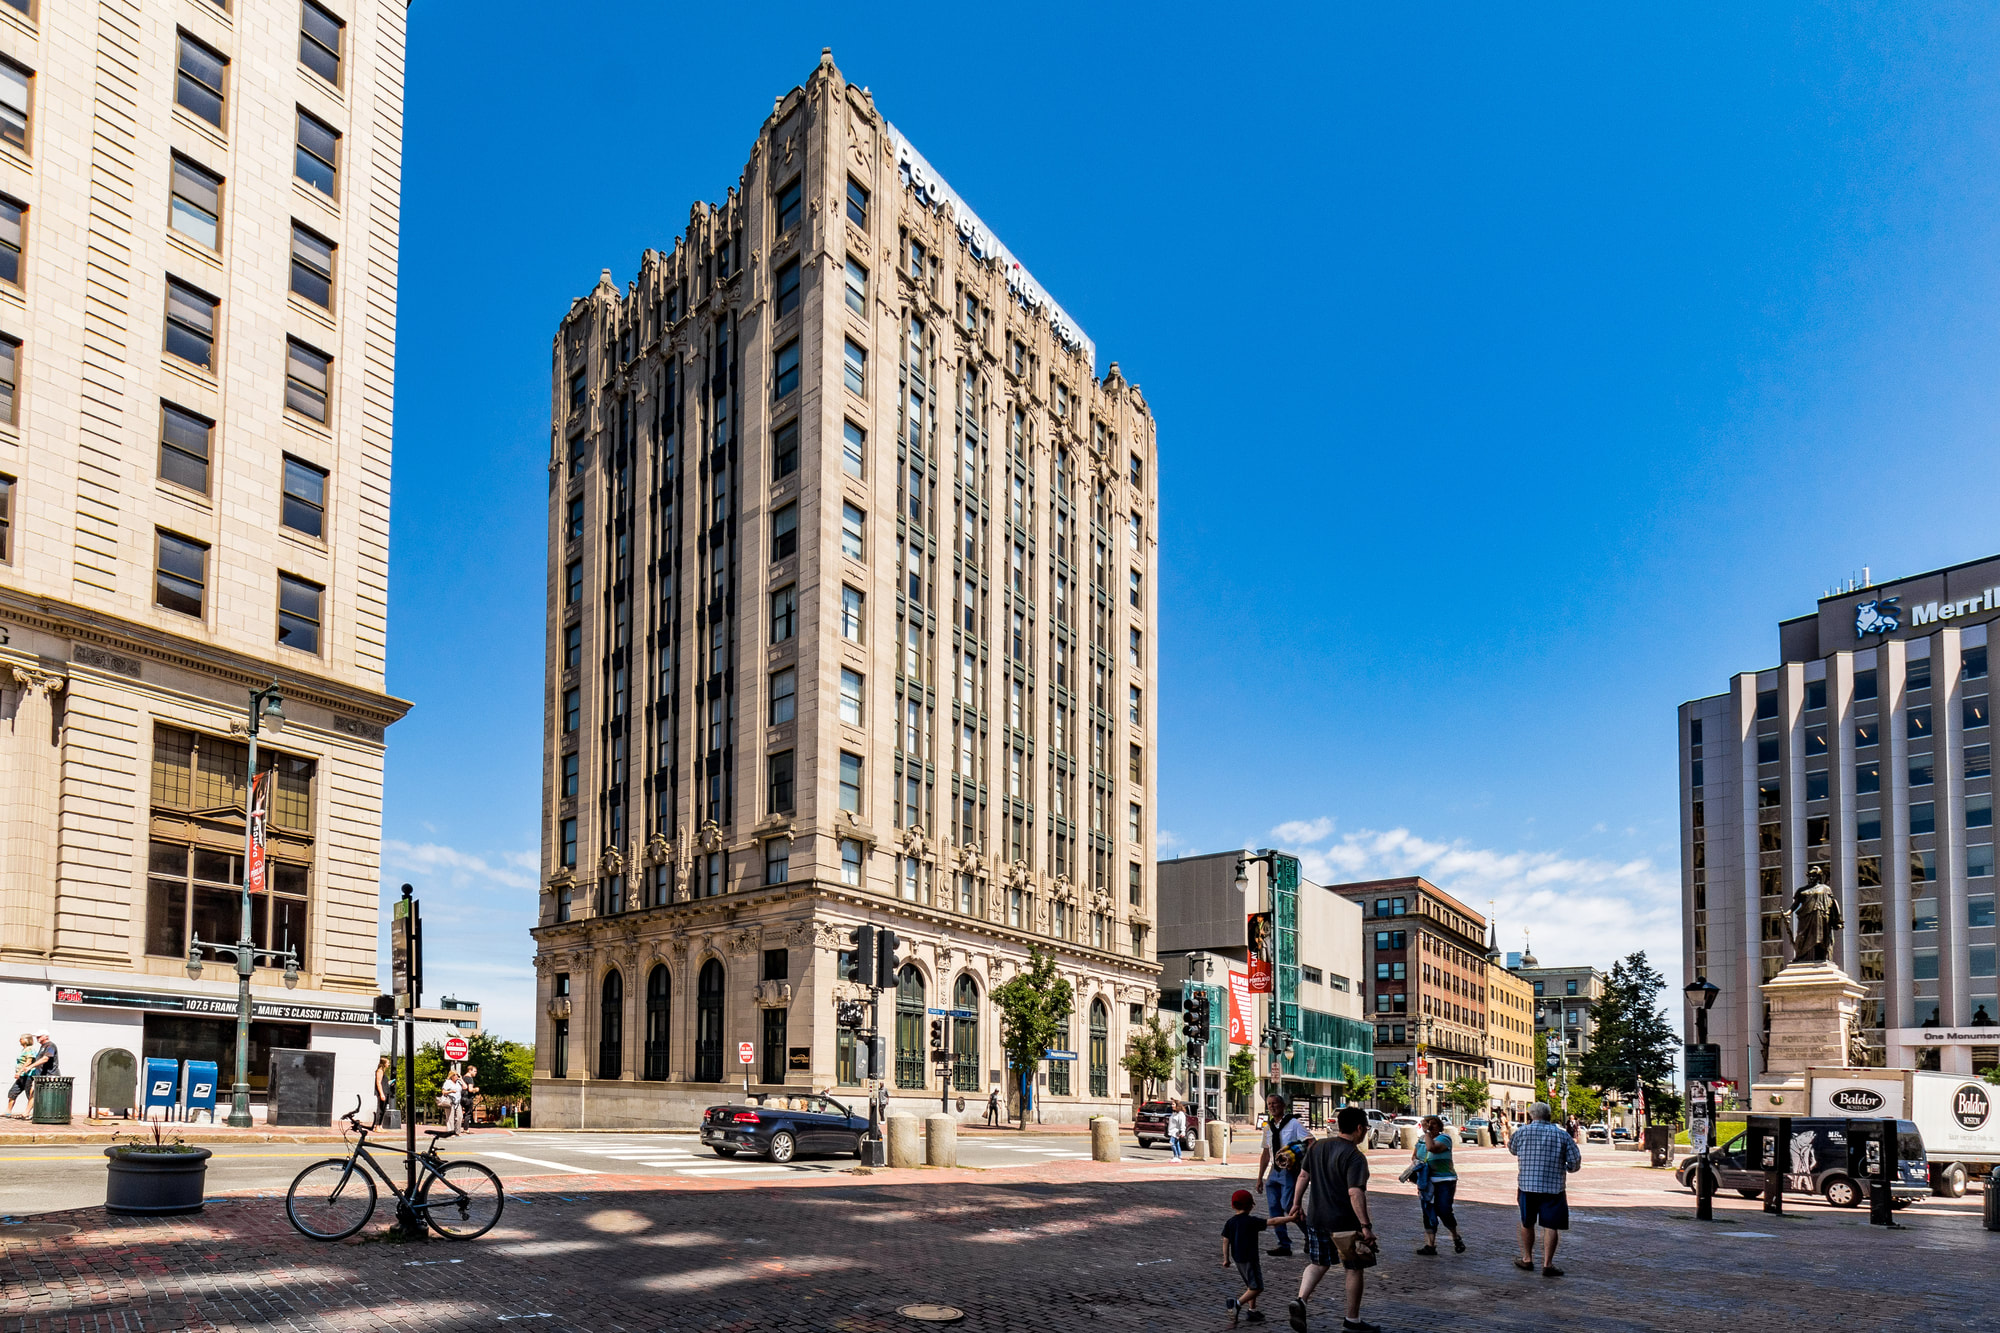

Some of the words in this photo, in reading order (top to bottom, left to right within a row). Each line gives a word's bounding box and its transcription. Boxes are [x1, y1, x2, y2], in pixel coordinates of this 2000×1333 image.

[185, 1000, 208, 1010] 107.5
[210, 1001, 238, 1013] FRANK
[258, 1005, 290, 1017] MAINE'S
[291, 1007, 322, 1019] CLASSIC
[322, 1009, 339, 1020] HITS
[340, 1010, 370, 1022] STATION
[1840, 1092, 1879, 1106] Baldor
[1957, 1093, 1988, 1115] Baldor
